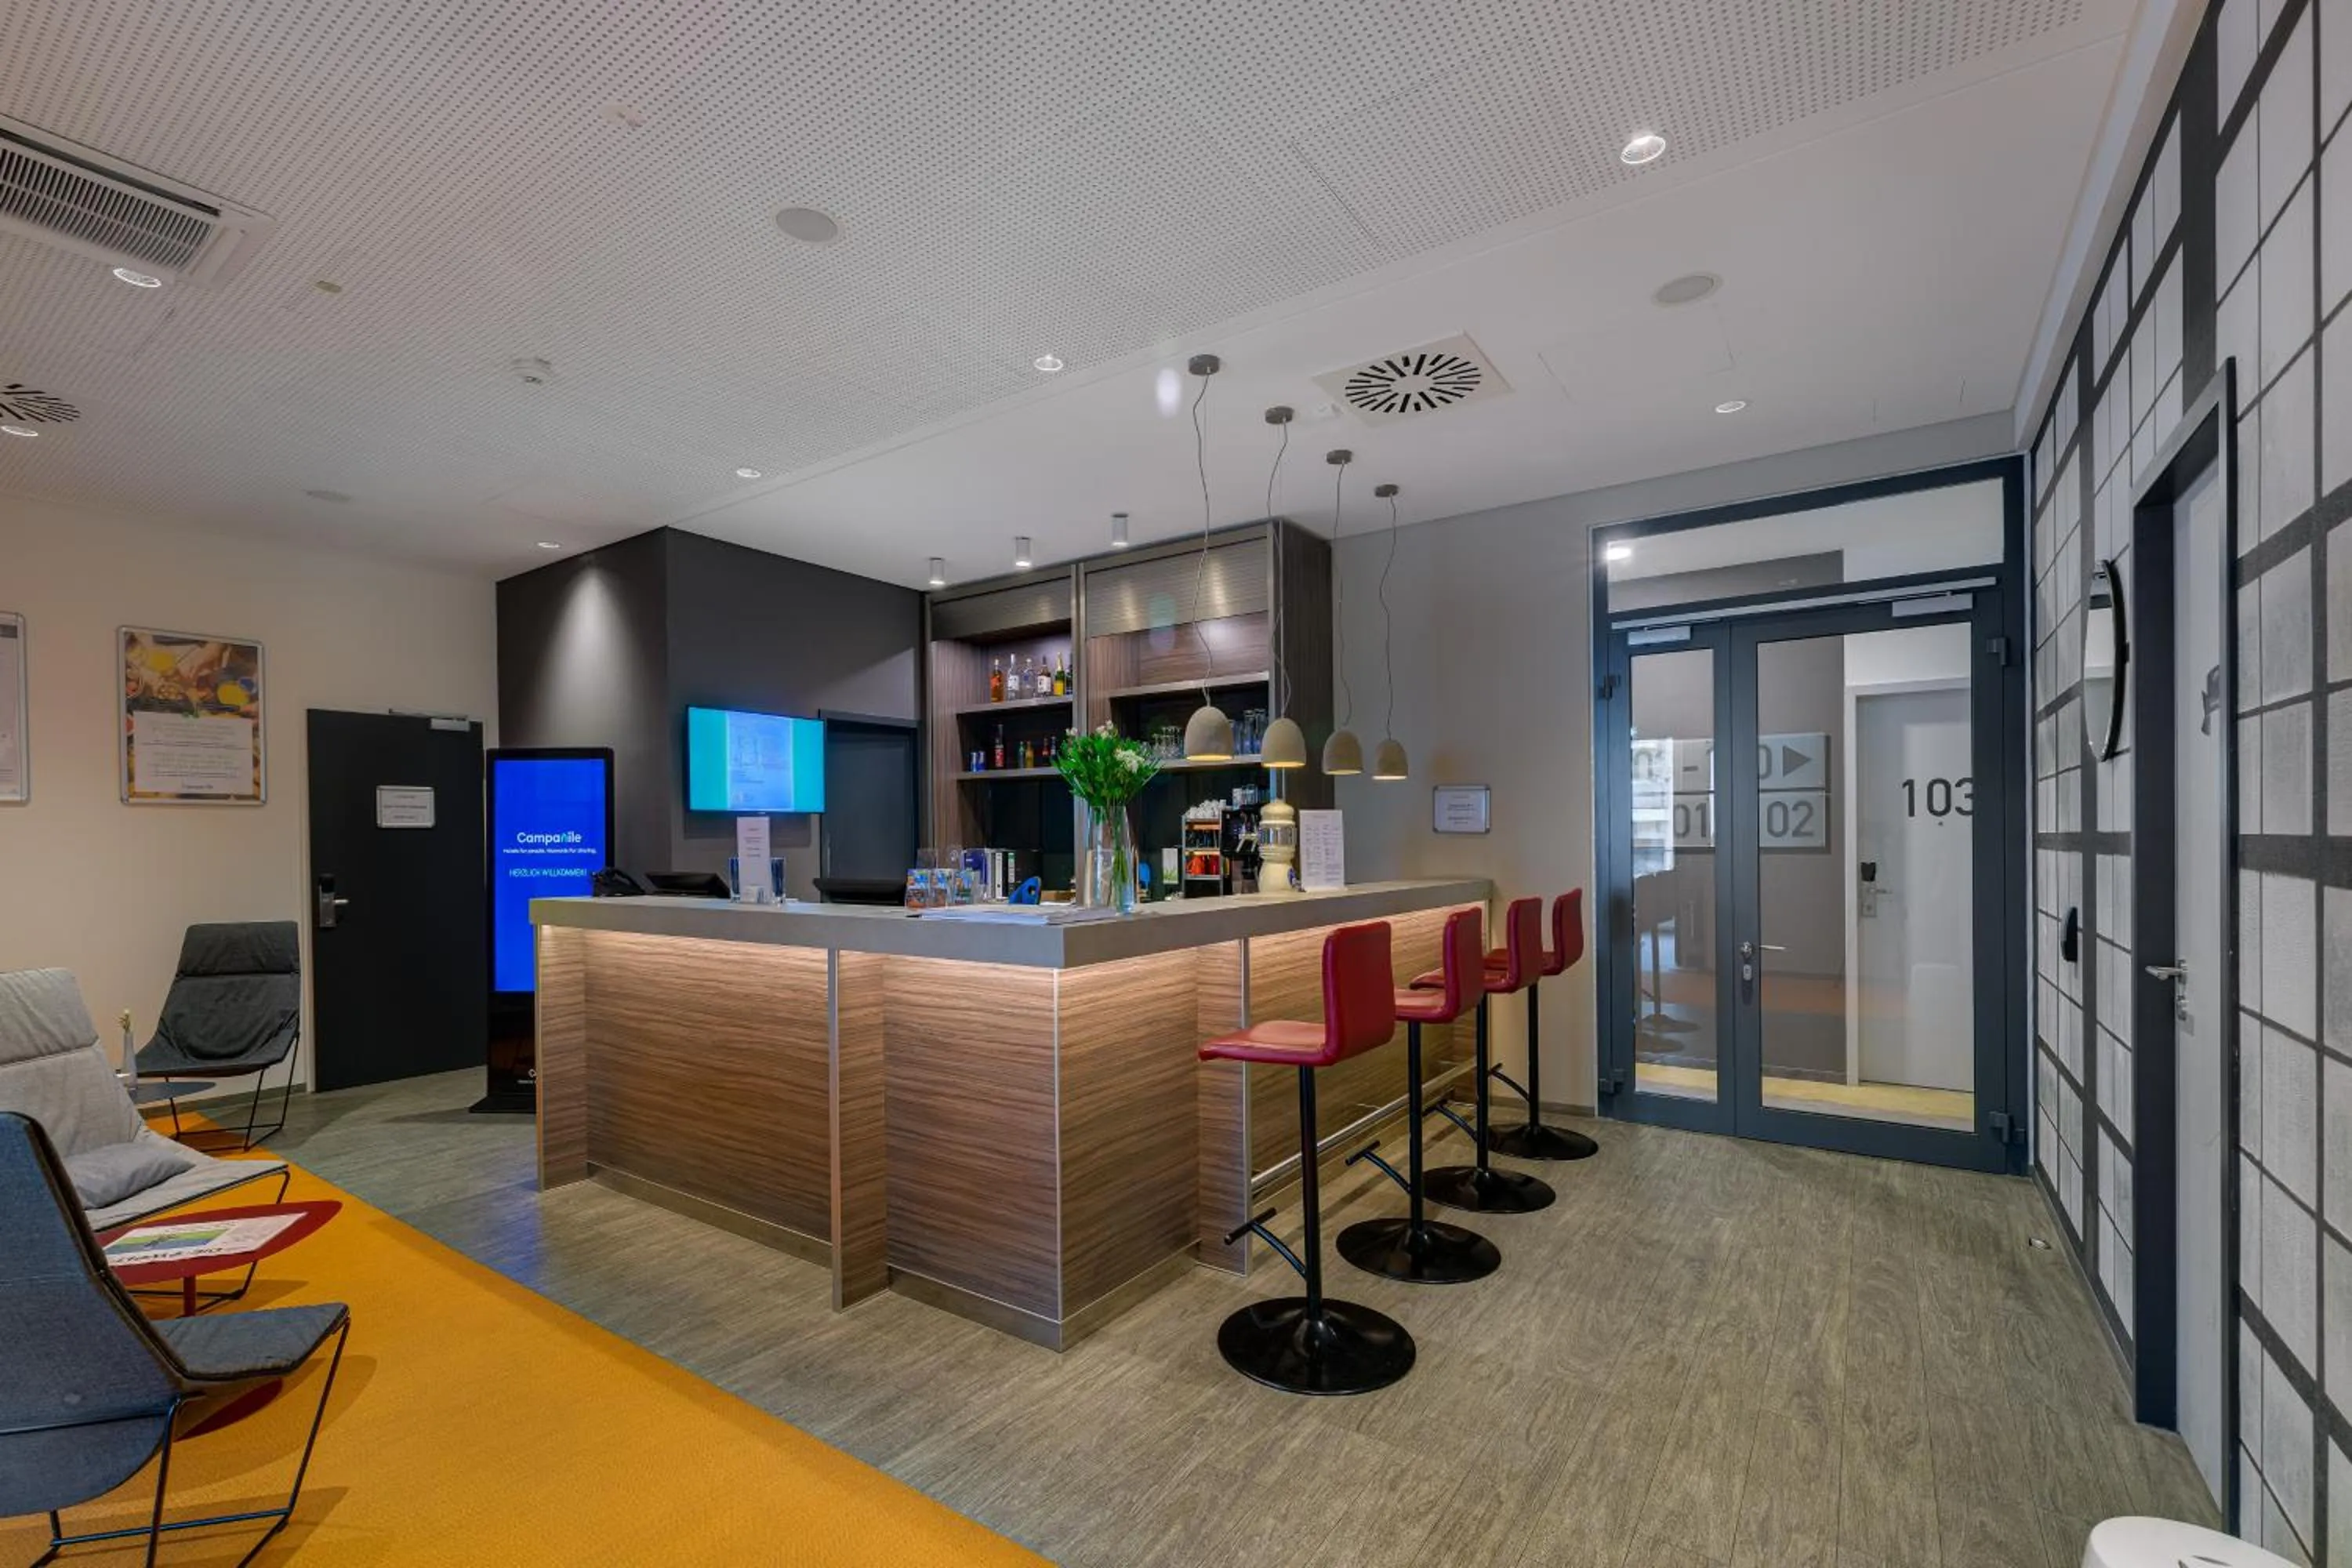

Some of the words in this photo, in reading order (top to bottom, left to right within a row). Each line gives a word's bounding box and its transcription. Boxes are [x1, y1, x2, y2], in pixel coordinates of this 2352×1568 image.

[1902, 777, 1973, 817] 103
[1672, 803, 1707, 838] 01
[1766, 800, 1813, 838] 02
[517, 831, 582, 846] Campanile
